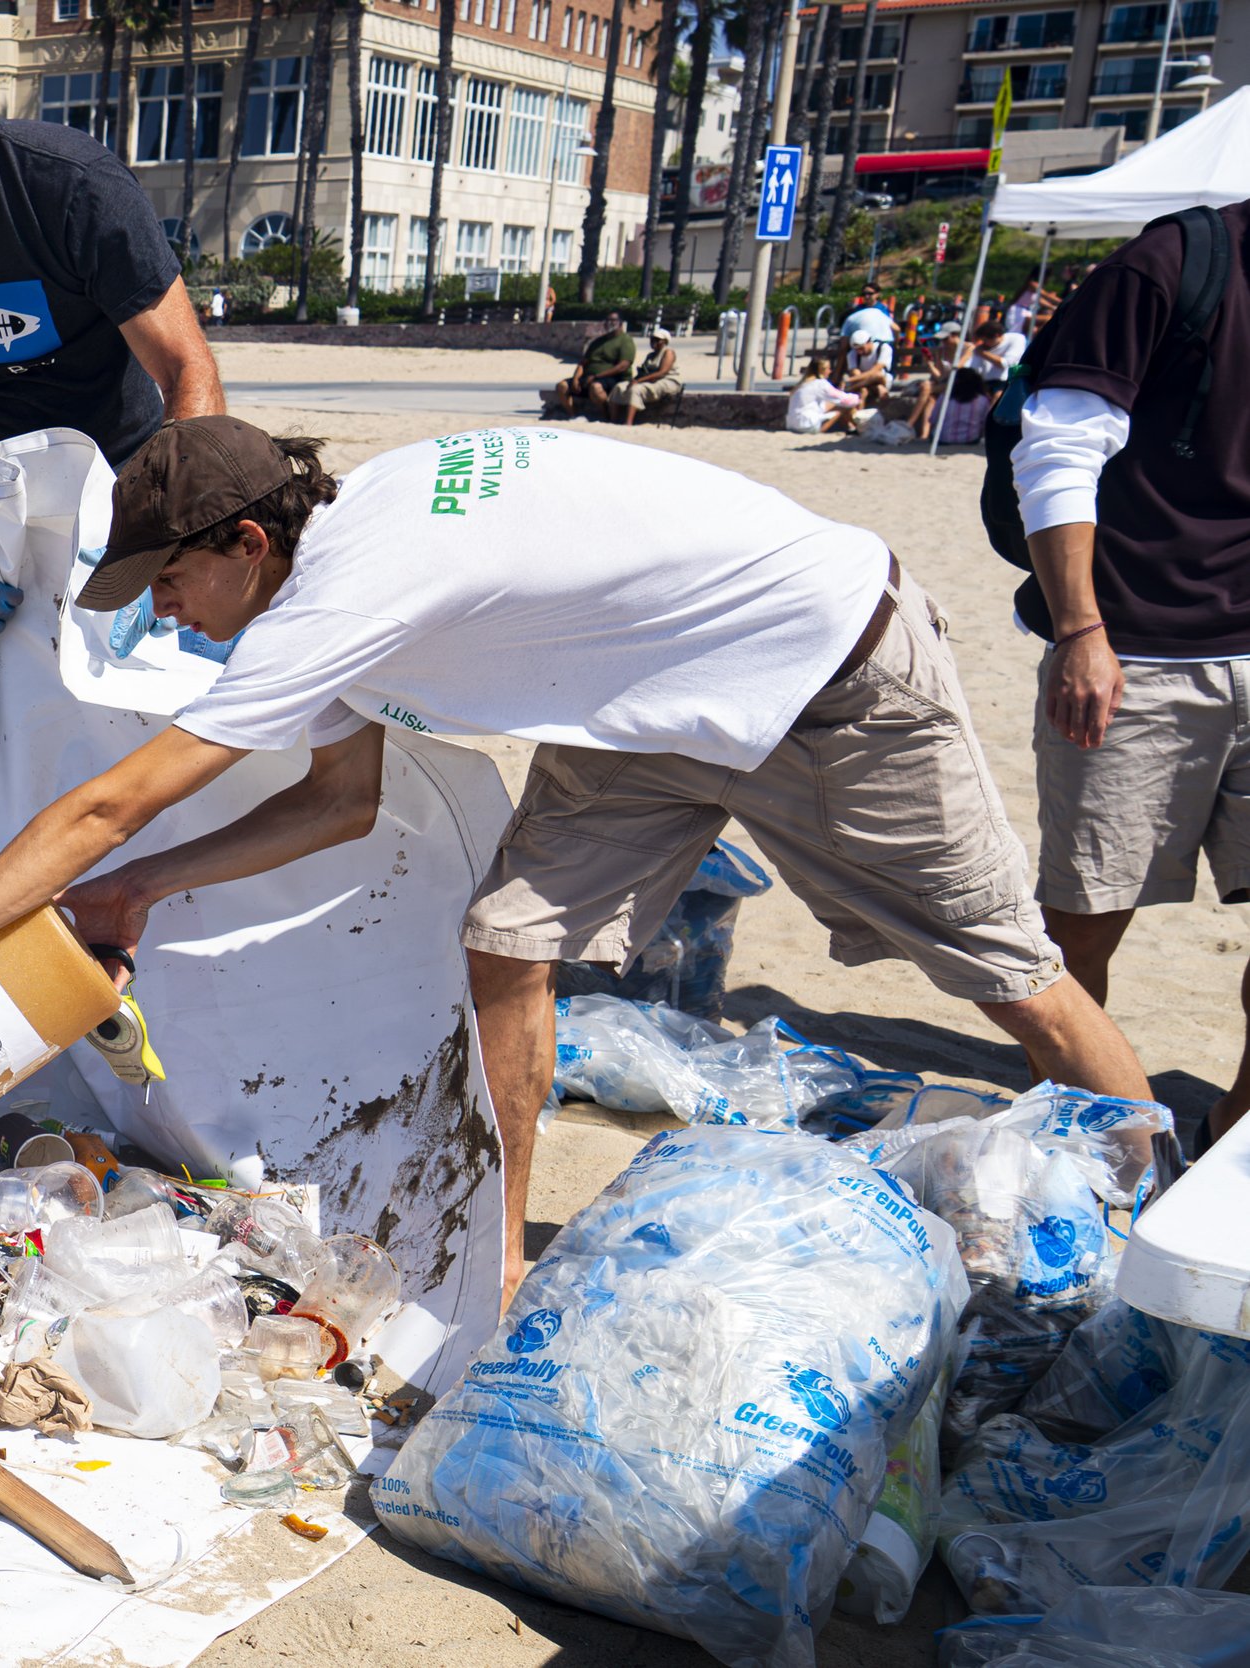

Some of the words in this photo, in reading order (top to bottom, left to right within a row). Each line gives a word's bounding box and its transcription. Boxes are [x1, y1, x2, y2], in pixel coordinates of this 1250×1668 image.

[478, 432, 505, 499] WILKES
[515, 433, 530, 469] ORIEN
[431, 448, 474, 515] PENN
[379, 702, 434, 734] RSITY
[734, 1402, 857, 1479] GreenPolly
[381, 1477, 410, 1495] 100%
[373, 1501, 410, 1516] ecycled
[412, 1503, 460, 1527] Plastics
